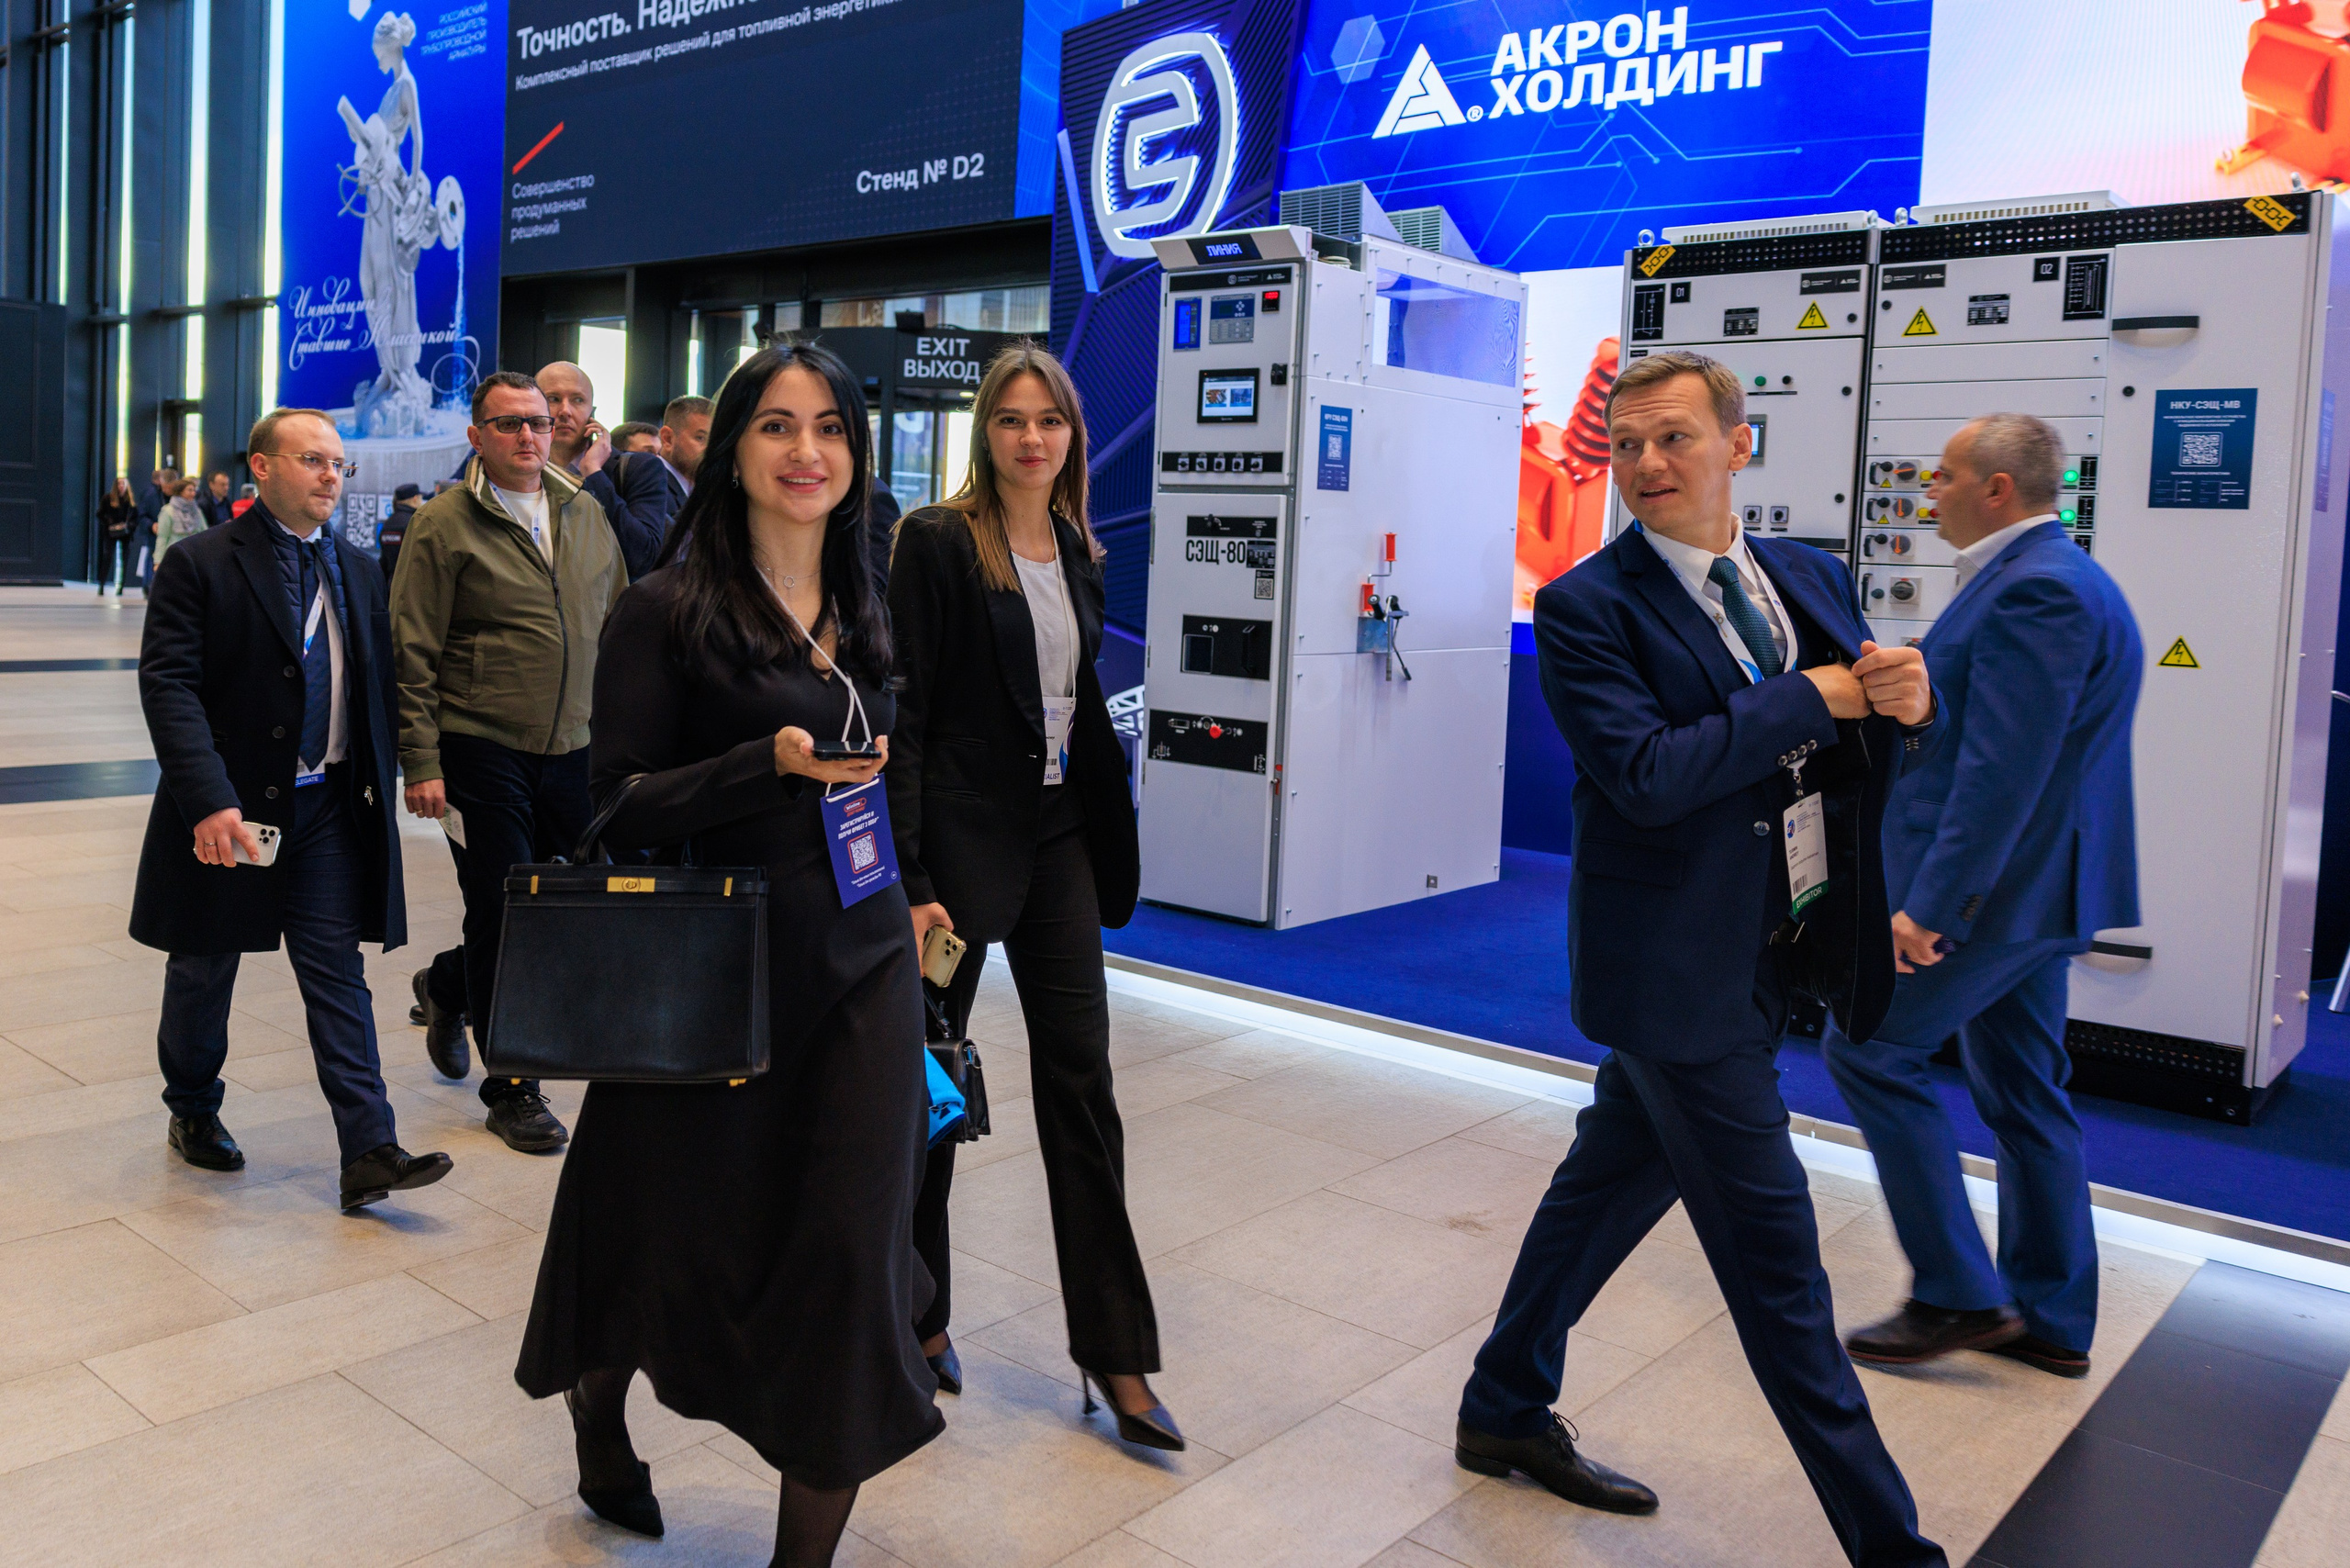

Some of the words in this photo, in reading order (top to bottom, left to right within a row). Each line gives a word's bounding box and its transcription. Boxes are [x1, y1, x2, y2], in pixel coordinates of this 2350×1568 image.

[515, 59, 588, 91] Комплексный
[589, 47, 653, 73] поставщик
[654, 30, 711, 62] решений
[711, 28, 735, 49] для
[737, 6, 811, 39] топливной
[516, 12, 632, 60] Точность.
[1490, 6, 1689, 77] АКРОН
[1488, 40, 1784, 119] ХОЛДИНГ
[856, 170, 919, 194] Стенд
[923, 158, 947, 185] №
[952, 152, 985, 180] D2
[511, 174, 596, 199] Совершенство
[510, 196, 588, 222] продуманных
[510, 218, 560, 244] решений
[1205, 242, 1243, 257] ЛИНИЯ
[2040, 263, 2053, 274] 02
[916, 336, 970, 357] EXIT
[903, 358, 981, 385] ВЫХОД
[2170, 399, 2242, 411] НКУ-СЭЩ-МВ
[1186, 539, 1247, 566] СЭЩ-80
[1796, 886, 1823, 909] EXHIBITOR
